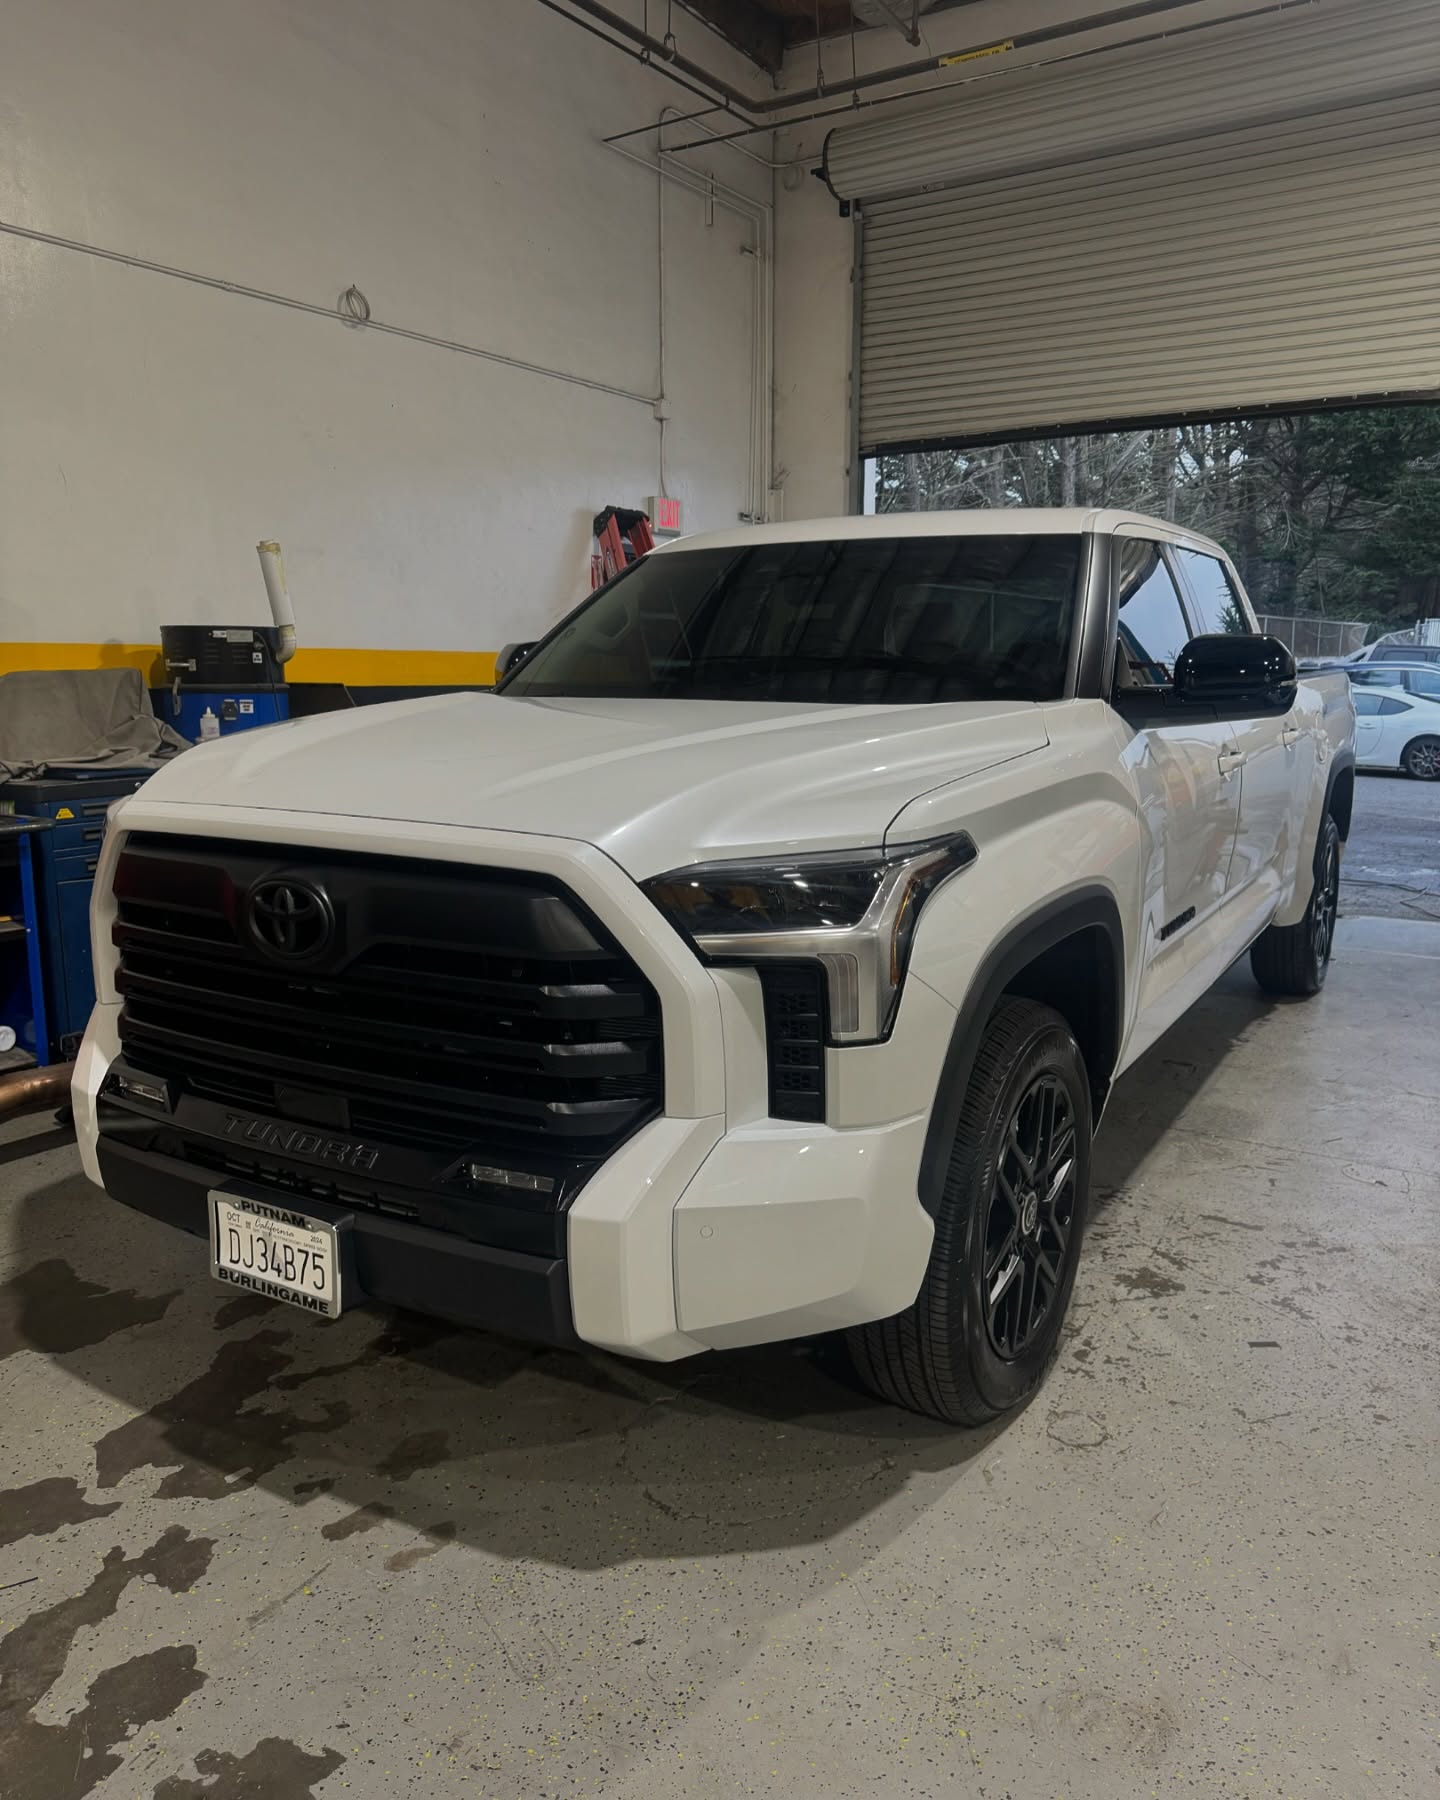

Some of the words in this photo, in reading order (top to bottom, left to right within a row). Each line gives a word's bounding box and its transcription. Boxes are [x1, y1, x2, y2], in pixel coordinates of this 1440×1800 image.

[659, 498, 680, 528] EXIT
[223, 1112, 379, 1169] TUNDRA
[226, 1210, 241, 1223] OCT
[240, 1199, 306, 1228] PUTNAM
[254, 1217, 295, 1237] California
[228, 1227, 325, 1290] DJ34B75
[218, 1267, 329, 1314] BURLINGAME
